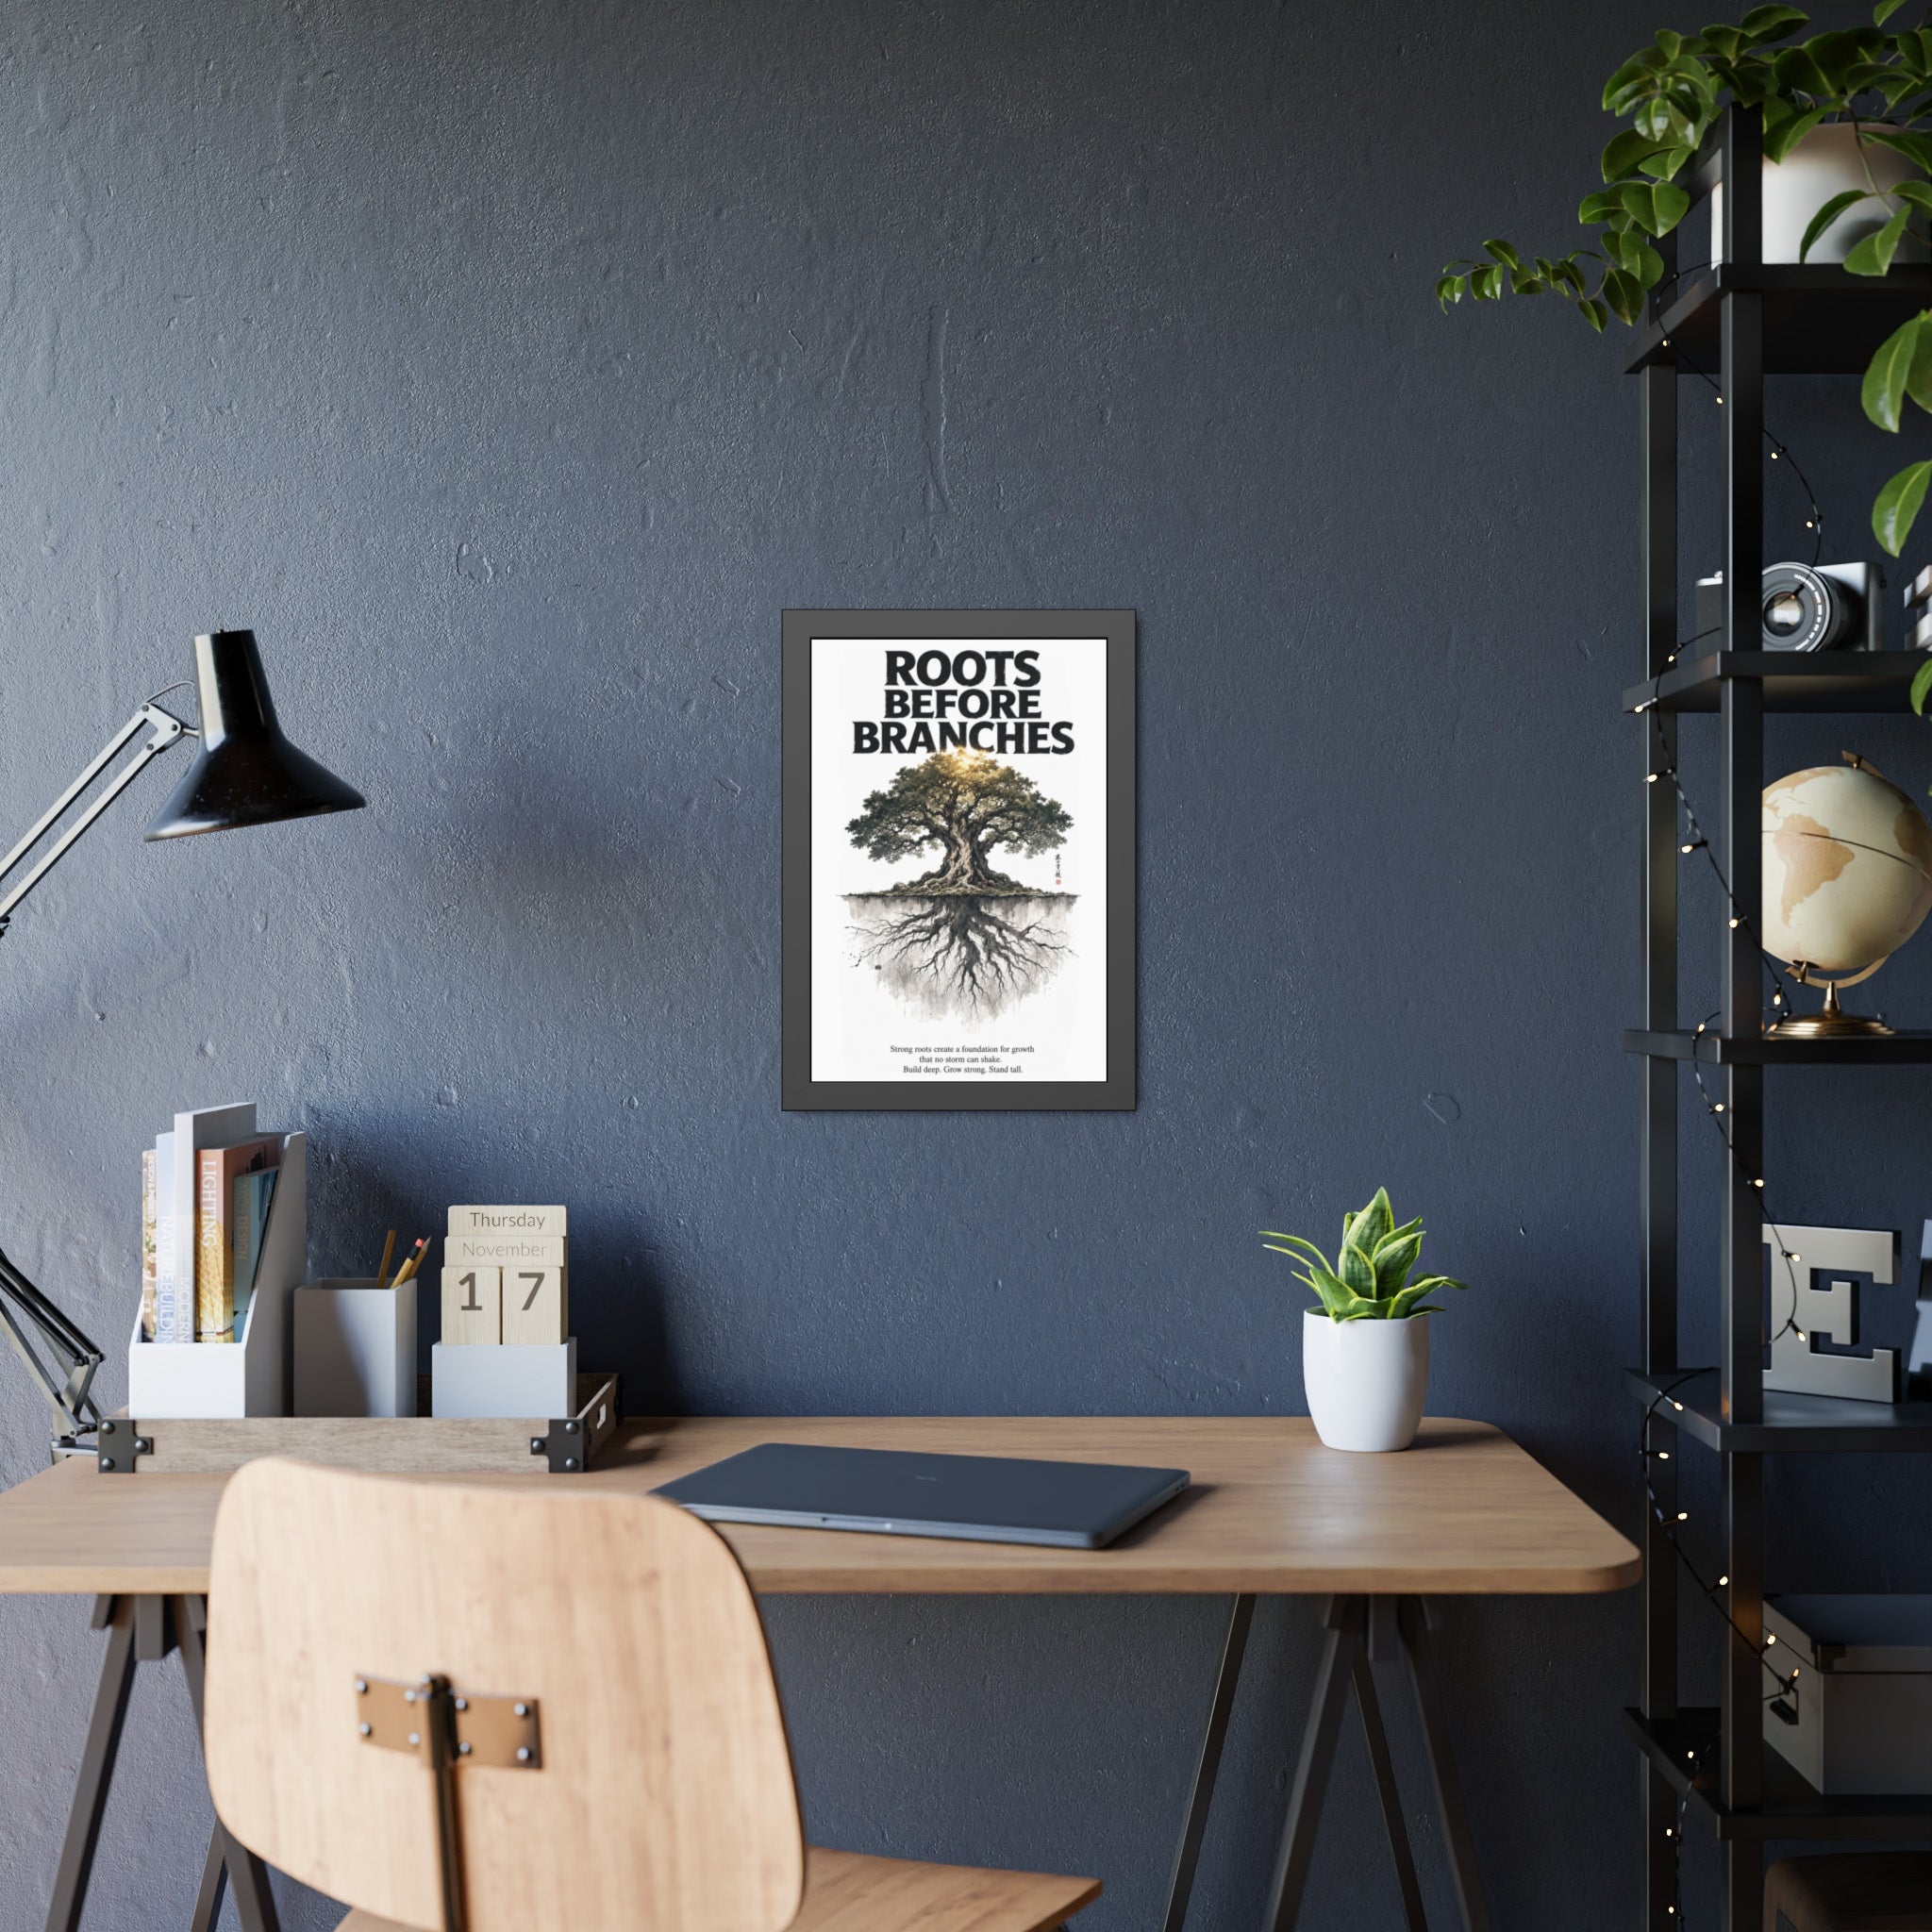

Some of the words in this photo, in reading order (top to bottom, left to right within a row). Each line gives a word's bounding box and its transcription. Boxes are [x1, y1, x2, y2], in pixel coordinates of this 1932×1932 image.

[884, 649, 1041, 688] ROOTS
[883, 689, 1042, 719] BEFORE
[852, 721, 1075, 755] BRANCHES
[890, 1045, 913, 1055] Strong
[1011, 1045, 1035, 1055] growth
[923, 1066, 942, 1074] deep.
[200, 1159, 217, 1247] LIGHTING
[237, 1216, 249, 1259] DESIGN
[469, 1211, 546, 1230] Thursday
[462, 1241, 547, 1257] November
[177, 1276, 191, 1342] MODERN
[1762, 1223, 1894, 1404] E
